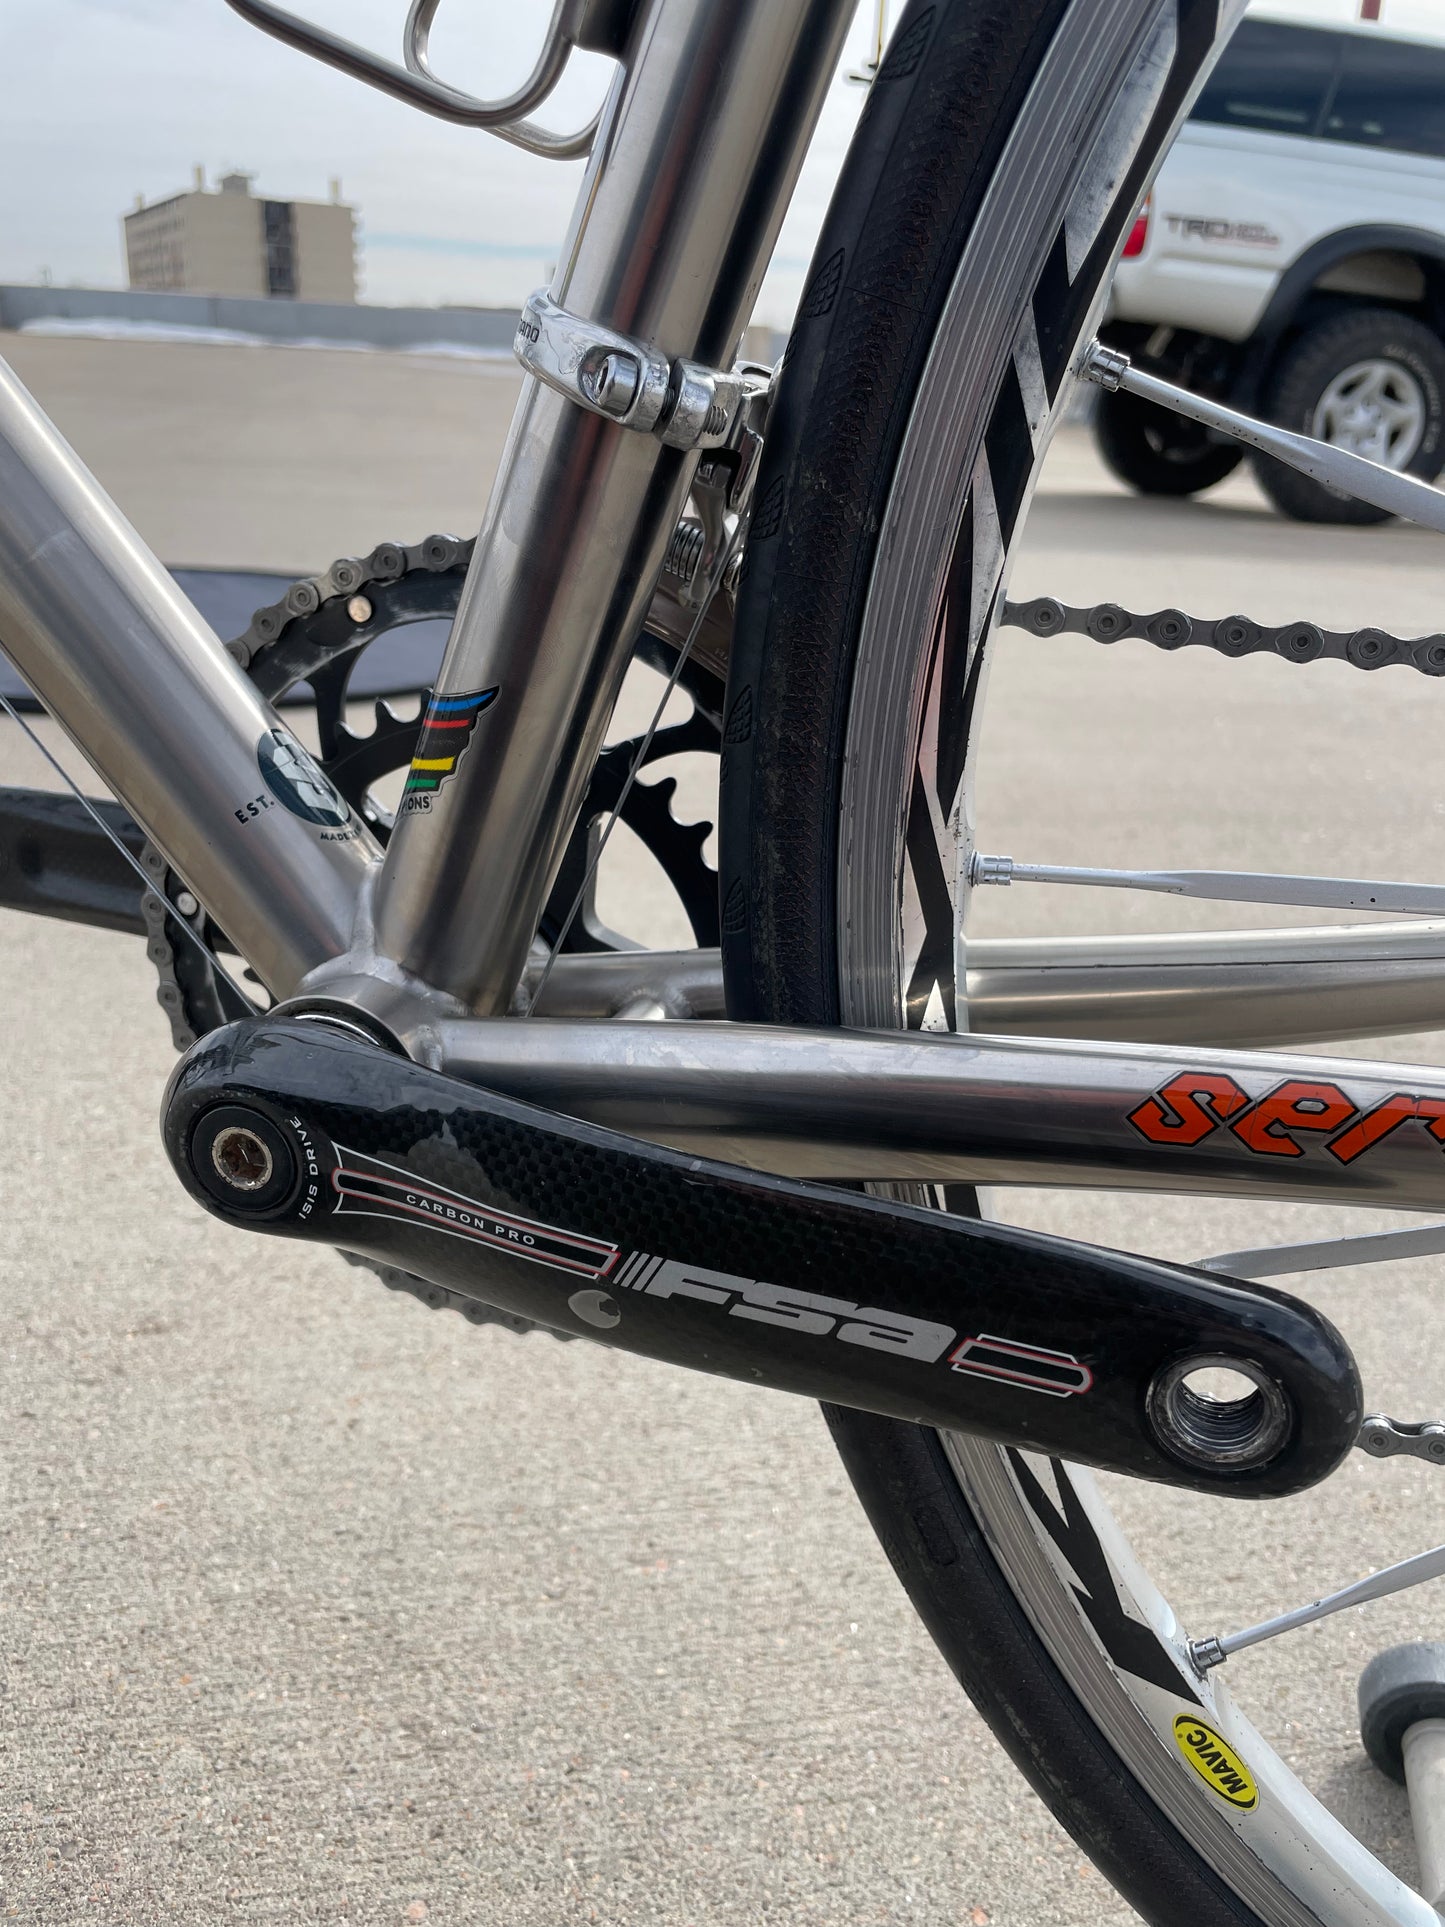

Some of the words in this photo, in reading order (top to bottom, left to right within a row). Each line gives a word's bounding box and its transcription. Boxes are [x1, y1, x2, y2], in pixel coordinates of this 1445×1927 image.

[234, 795, 274, 824] EST.
[289, 1115, 319, 1176] DRIVE
[298, 1184, 319, 1220] ISIS
[406, 1194, 485, 1229] CARBON
[495, 1225, 535, 1246] PRO
[1186, 1729, 1249, 1795] MAVIC
